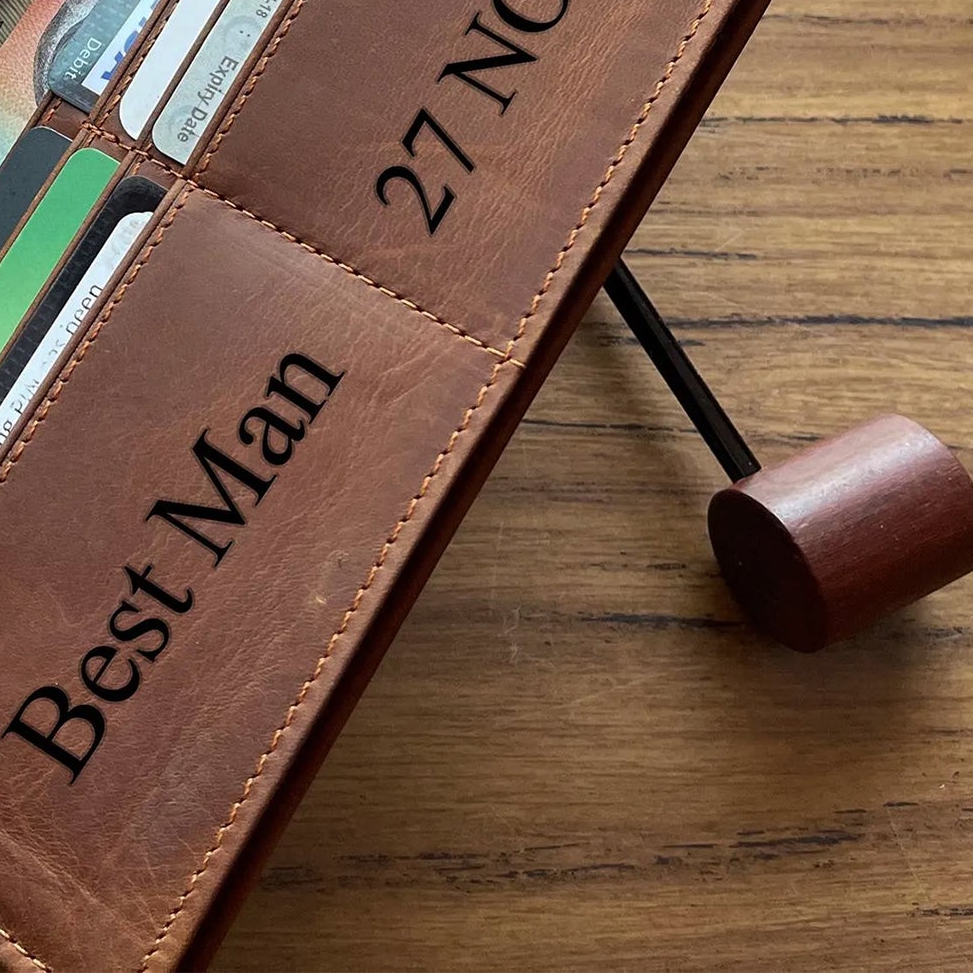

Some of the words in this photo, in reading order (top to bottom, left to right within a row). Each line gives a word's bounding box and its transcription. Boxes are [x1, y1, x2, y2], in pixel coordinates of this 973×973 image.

[64, 34, 103, 80] Debit
[197, 55, 240, 106] Expiry
[177, 106, 209, 143] Date
[375, 107, 475, 235] 27
[1, 561, 194, 786] Best
[145, 350, 347, 568] Man
